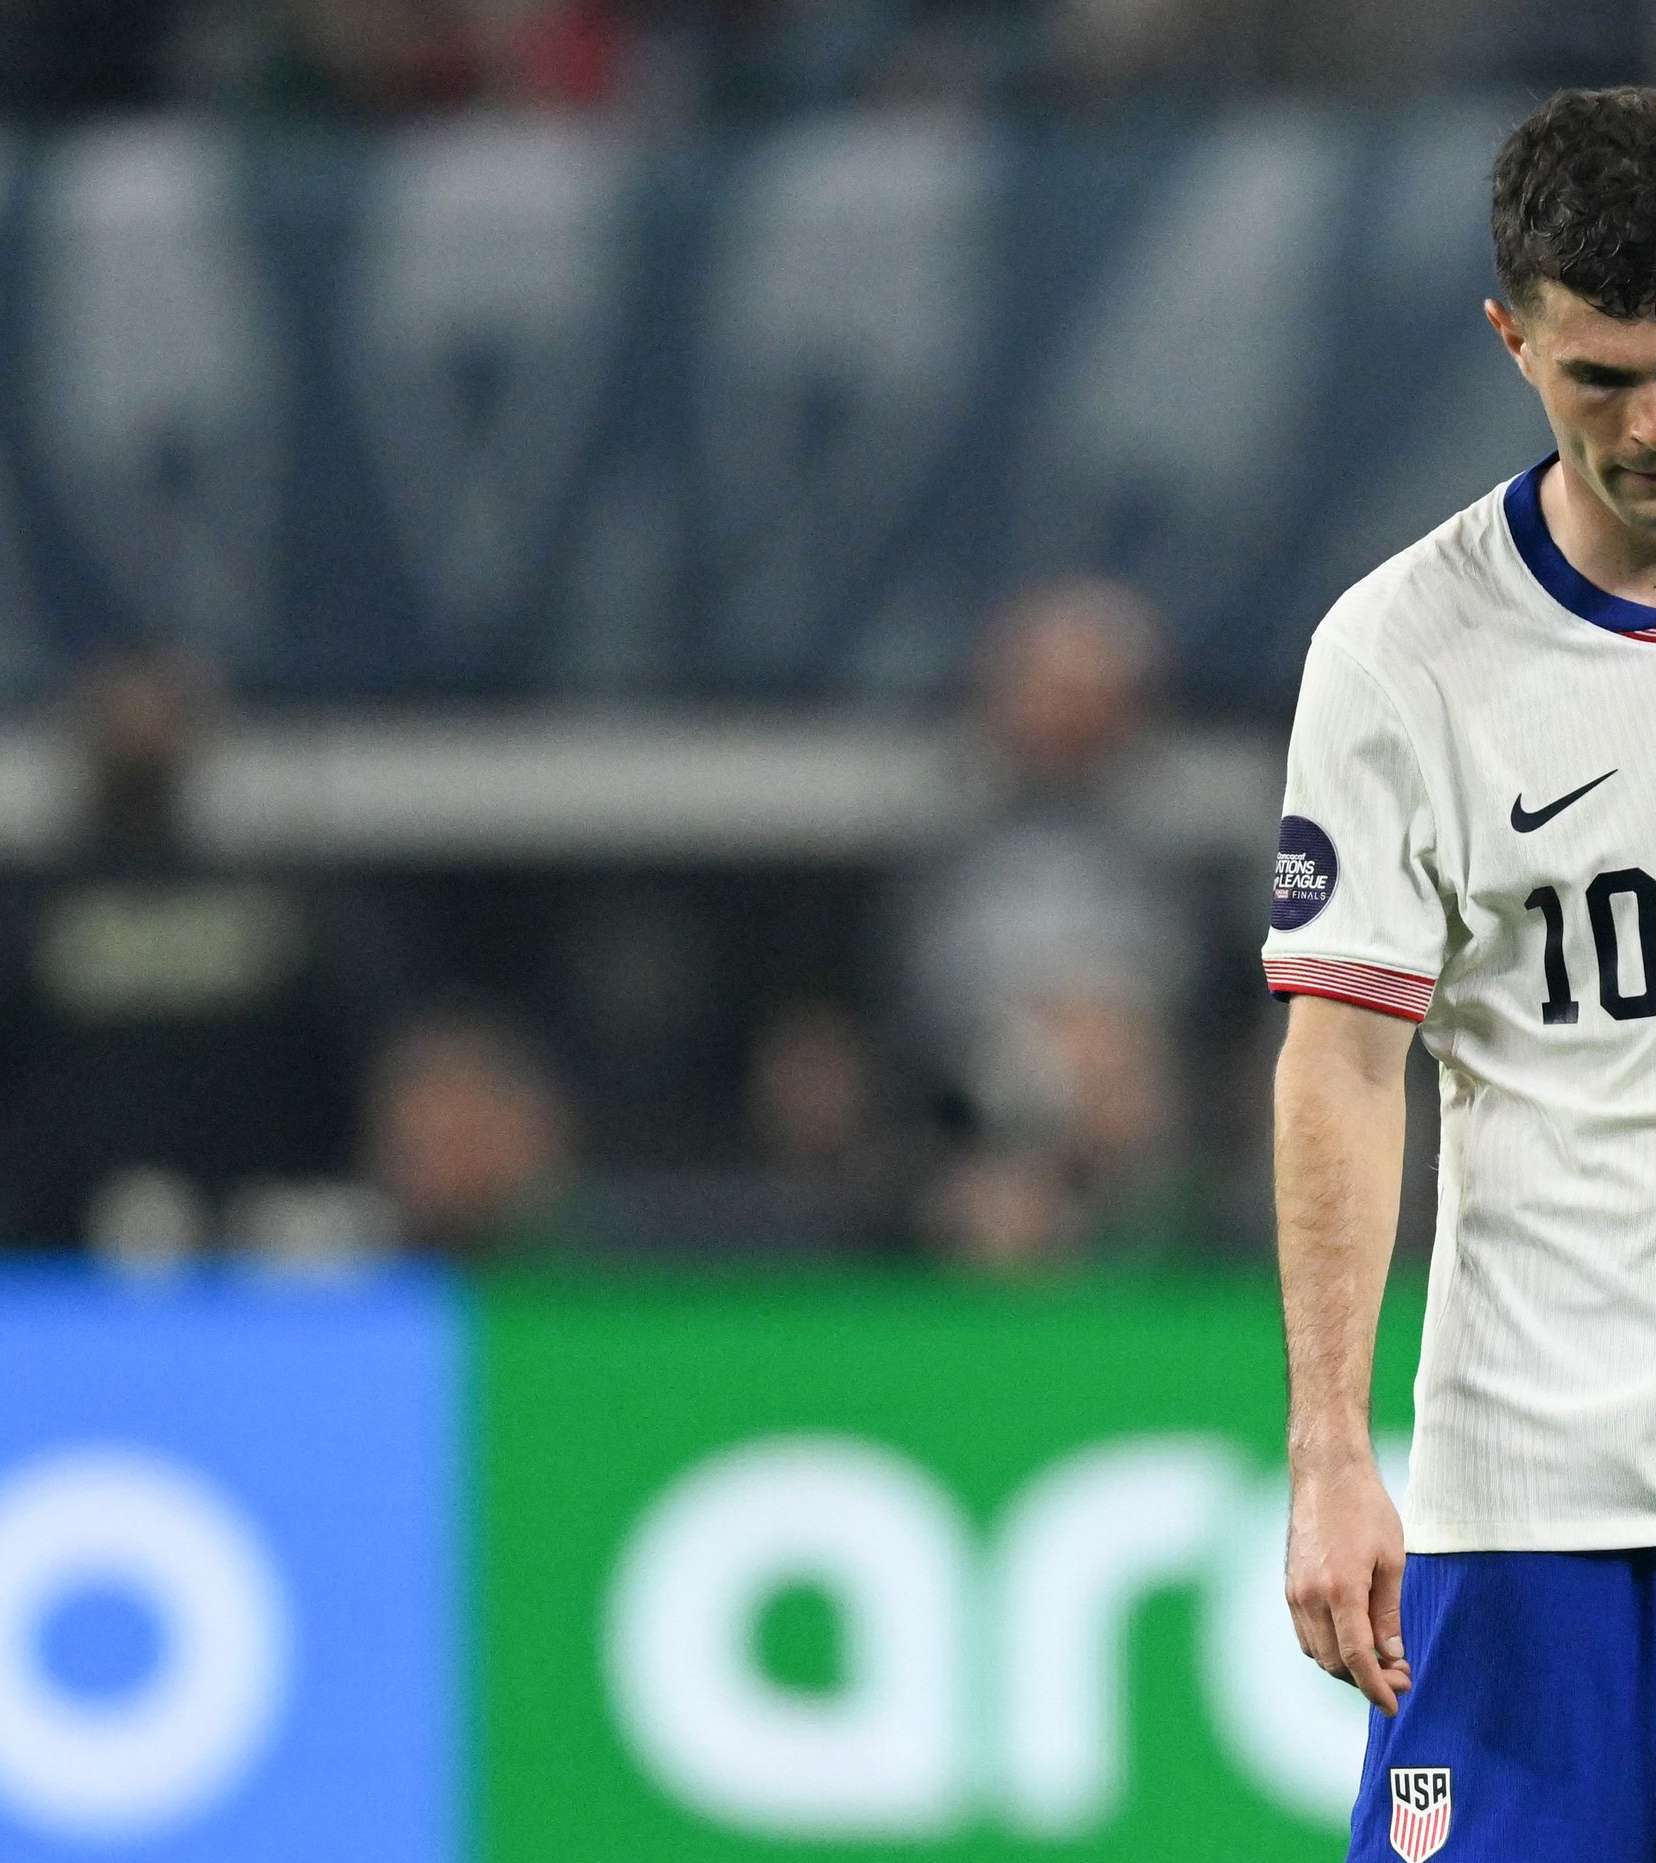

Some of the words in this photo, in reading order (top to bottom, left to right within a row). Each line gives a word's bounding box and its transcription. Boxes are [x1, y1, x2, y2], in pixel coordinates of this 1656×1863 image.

[1275, 860, 1315, 874] ATIONS
[1279, 873, 1329, 889] LEAGUE
[1292, 890, 1327, 901] FINALS
[1395, 1773, 1447, 1811] USA
